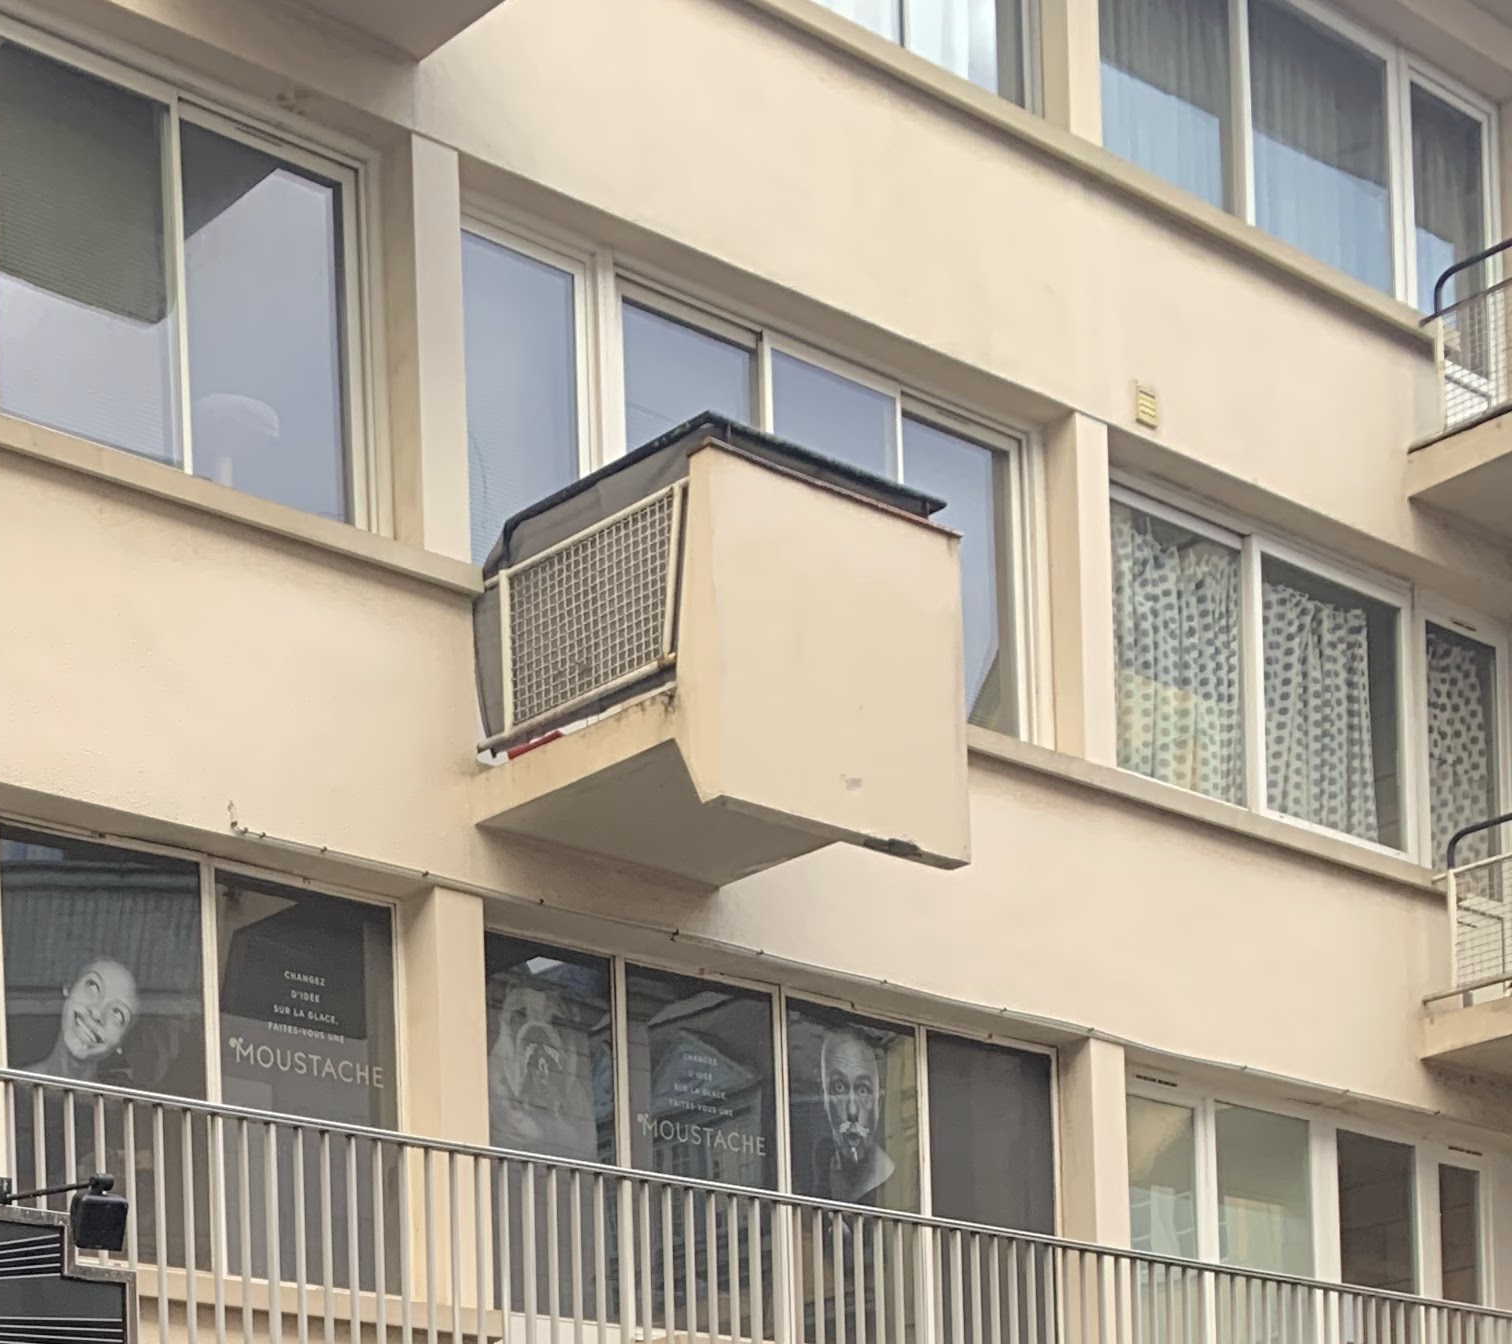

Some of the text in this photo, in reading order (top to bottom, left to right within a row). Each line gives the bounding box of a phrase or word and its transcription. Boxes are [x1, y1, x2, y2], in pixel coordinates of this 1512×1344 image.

[284, 970, 326, 986] CHANGEZ
[273, 1004, 290, 1014] SUR
[294, 1008, 304, 1017] LA
[268, 1022, 345, 1044] FAITES-VOUS UNE
[231, 1039, 384, 1088] MOUSTACHE
[639, 1115, 766, 1155] MOUSTACHE
